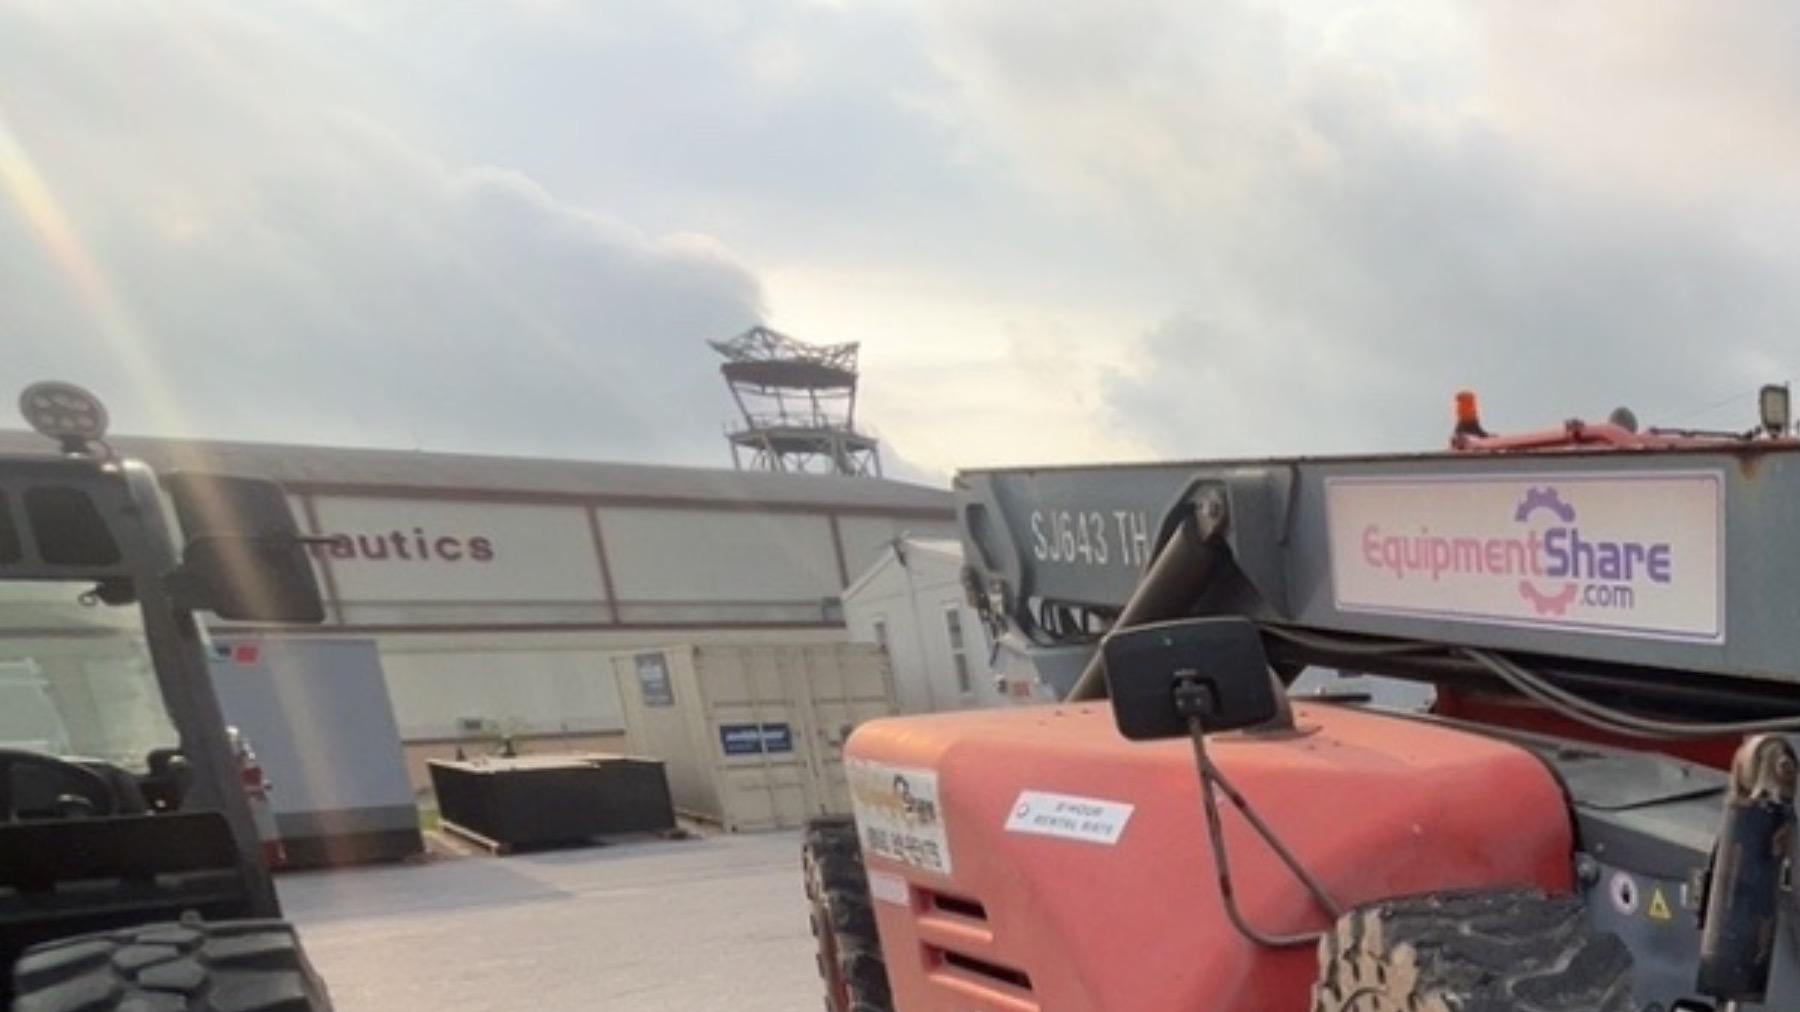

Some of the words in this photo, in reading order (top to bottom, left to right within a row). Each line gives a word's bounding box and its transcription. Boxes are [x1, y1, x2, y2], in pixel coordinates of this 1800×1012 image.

[1031, 510, 1108, 565] SJ643
[1112, 510, 1151, 567] TH
[1361, 524, 1671, 582] EquipmentShare
[1579, 583, 1635, 609] .com
